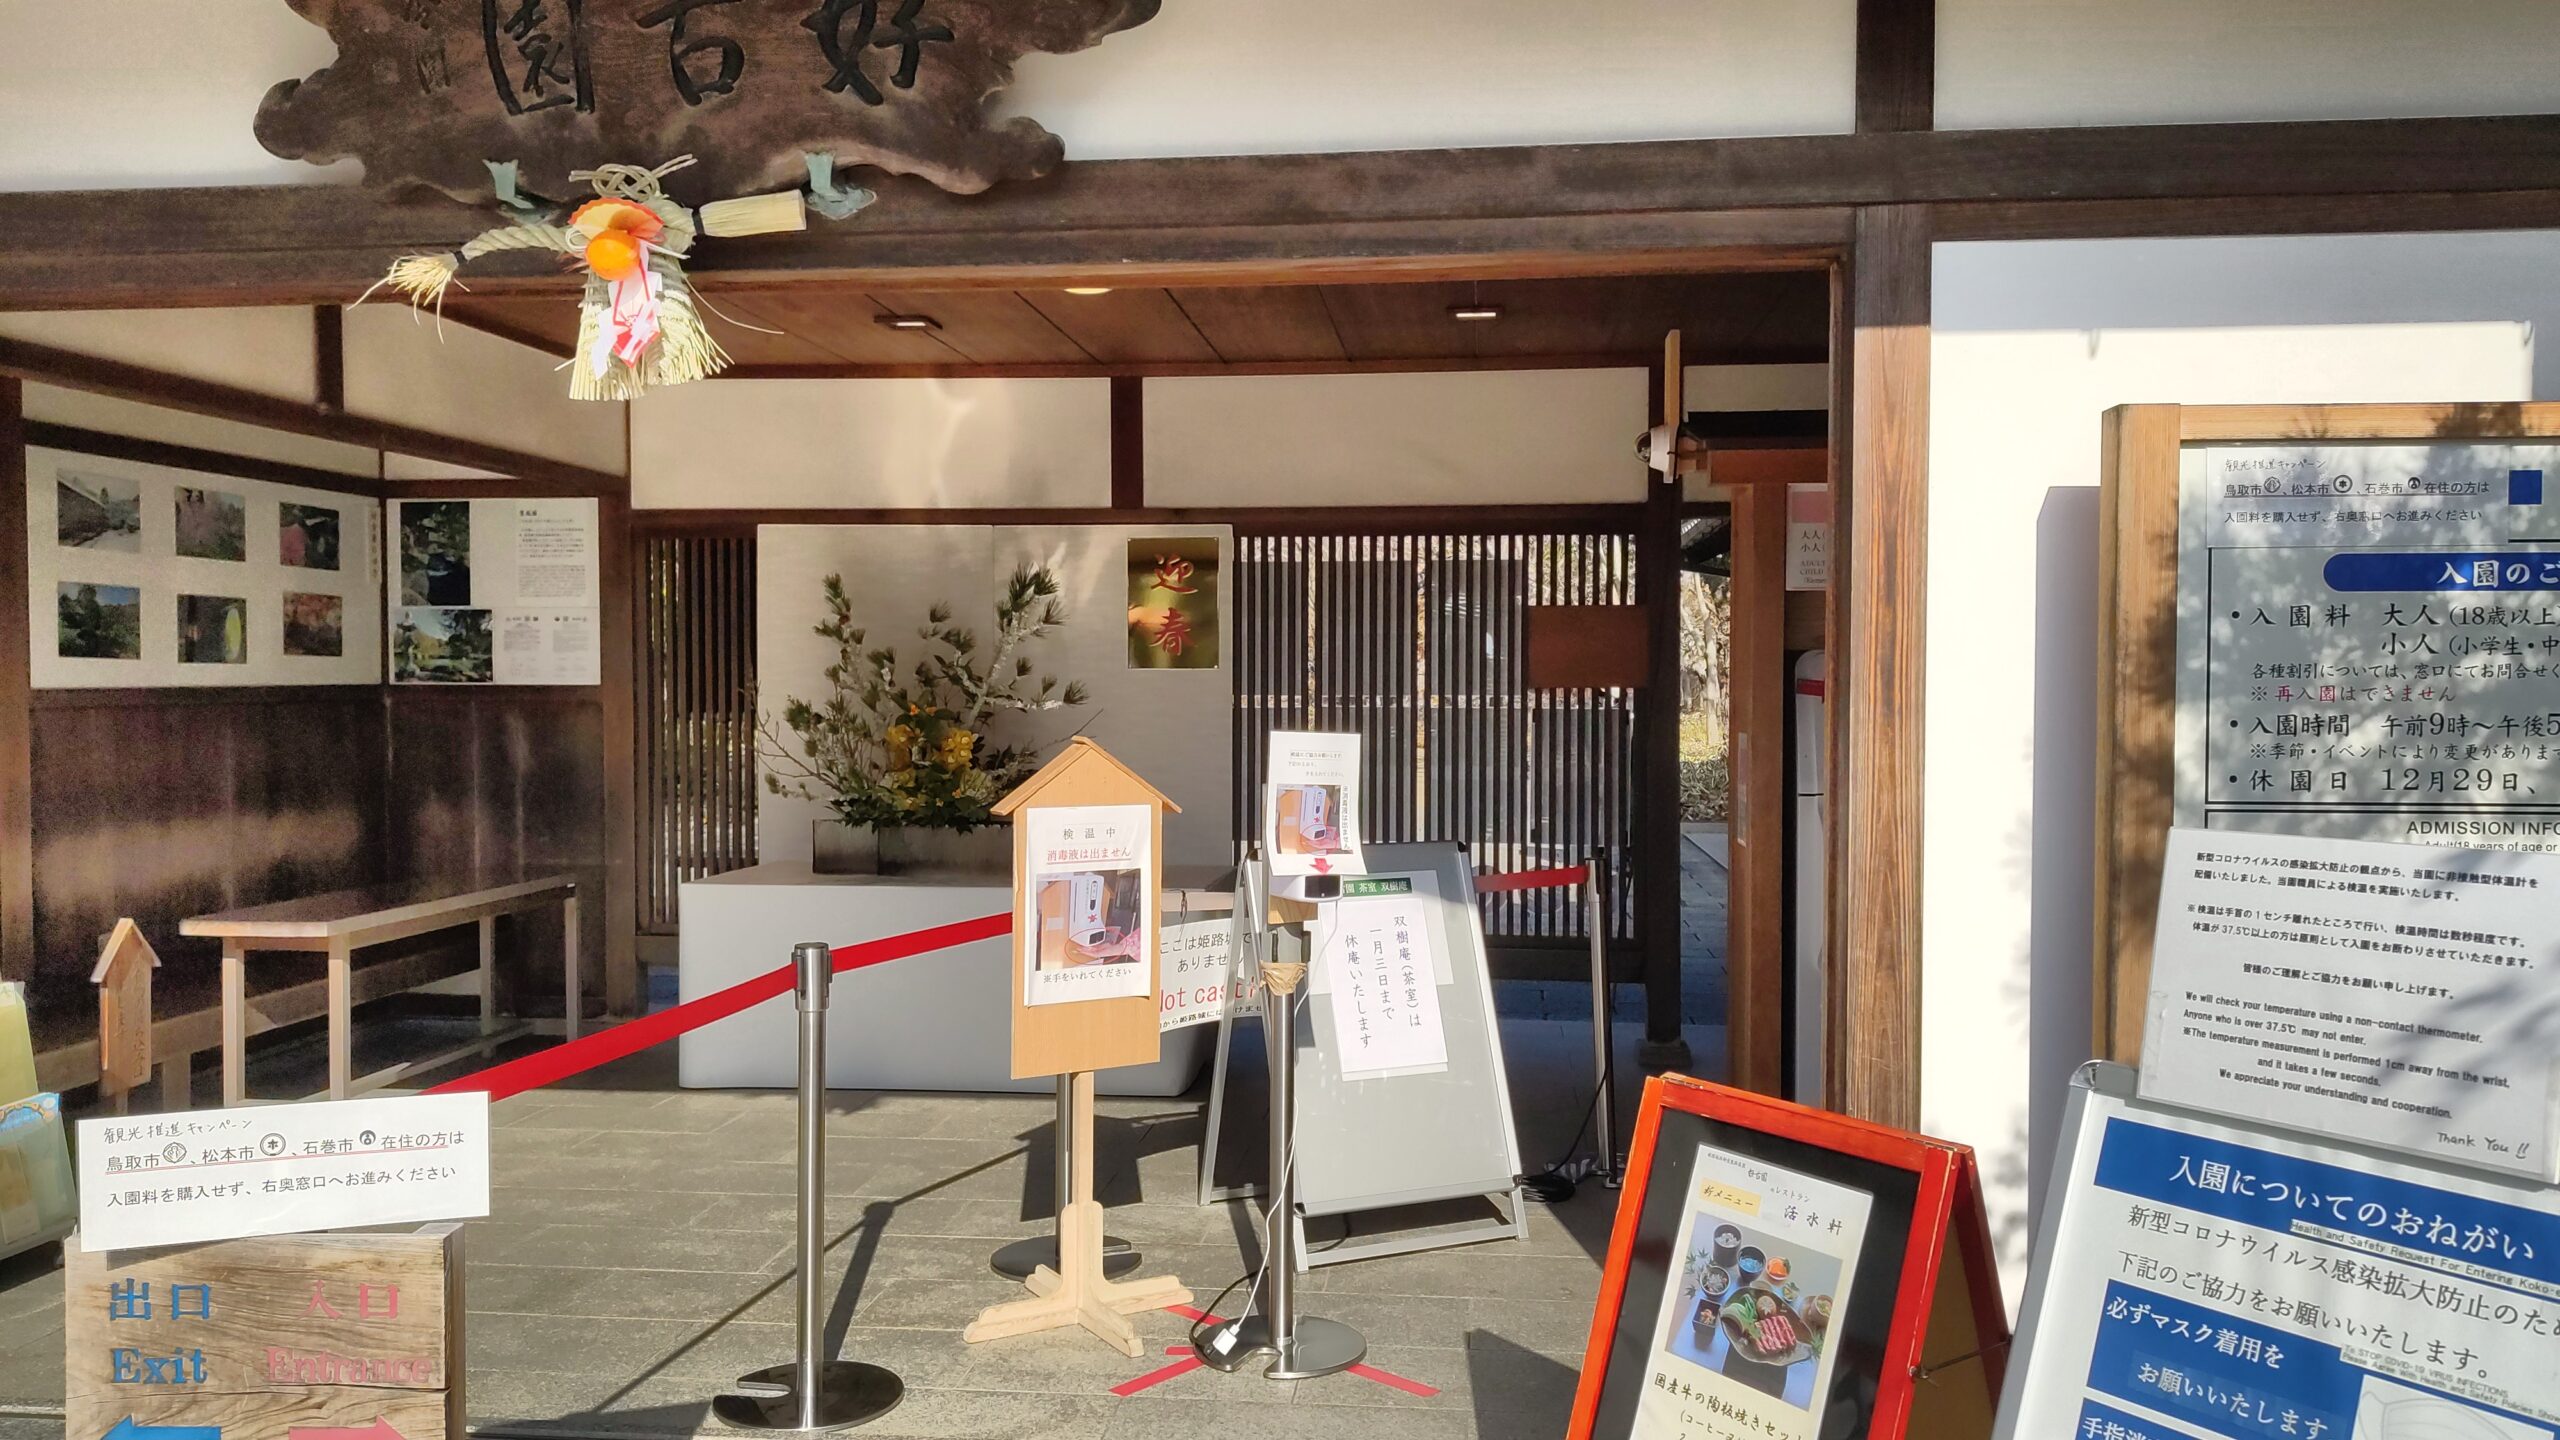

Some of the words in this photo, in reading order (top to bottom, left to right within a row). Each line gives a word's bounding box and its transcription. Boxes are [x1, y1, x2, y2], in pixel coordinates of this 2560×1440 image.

[2250, 603, 2350, 628] 入園料
[2249, 713, 2350, 737] 入園時間
[2249, 769, 2347, 793] 休園日
[1063, 826, 1116, 841] 検温中
[2406, 821, 2515, 836] ADMISSION
[1047, 847, 1131, 862] 消毒液は出ません
[1344, 934, 1372, 1049] 休庵いたします
[1370, 927, 1395, 1020] 一月三日まで
[2184, 1009, 2213, 1022] Anyone
[2215, 1014, 2231, 1024] who
[2234, 1016, 2242, 1026] is
[2244, 1019, 2262, 1029] over
[2301, 1027, 2319, 1038] may
[2322, 1030, 2336, 1041] not
[2340, 1032, 2367, 1046] enter.
[2185, 991, 2198, 1001] We
[2200, 994, 2213, 1003] will
[2215, 996, 2240, 1007] check
[2243, 1001, 2261, 1011] your
[2263, 1003, 2316, 1019] temperature
[2319, 1012, 2343, 1023] using
[2355, 1016, 2414, 1033] non-contact
[2417, 1025, 2483, 1043] thermometer.
[2209, 1031, 2260, 1047] temperature
[2261, 1040, 2320, 1056] measurement
[2322, 1049, 2330, 1059] is
[2333, 1051, 2381, 1067] performed
[2385, 1058, 2405, 1071] 1cm
[2408, 1064, 2433, 1076] away
[2436, 1067, 2459, 1080] from
[2462, 1071, 2479, 1083] the
[2482, 1075, 2510, 1088] wrist.
[2257, 1057, 2273, 1069] and
[2276, 1059, 2282, 1069] it
[2285, 1061, 2309, 1074] takes
[2312, 1067, 2318, 1075] a
[2321, 1067, 2337, 1079] few
[2340, 1072, 2381, 1087] seconds.
[2219, 1068, 2231, 1078] We
[2234, 1072, 2279, 1087] appreciate
[2282, 1082, 2301, 1092] your
[2304, 1084, 2368, 1104] understanding
[2371, 1096, 2389, 1107] and
[2392, 1100, 2453, 1119] cooperation.
[106, 1153, 161, 1172] 鳥取市
[380, 1130, 465, 1151] 在住の方は
[2437, 1132, 2476, 1147] Thank
[2484, 1136, 2509, 1153] You
[107, 1166, 456, 1208] 入園料を購入せず、右奥窓口へお進みください
[2168, 1155, 2534, 1260] 入園についてのおねがい
[1784, 1205, 1843, 1236] 活水軒
[2326, 1231, 2345, 1242] and
[2350, 1236, 2386, 1253] Safety
[2391, 1246, 2435, 1266] Request
[2441, 1258, 2460, 1271] For
[2465, 1264, 2513, 1285] Entering
[109, 1277, 212, 1321] 出口
[301, 1281, 399, 1320] 入口
[2118, 1249, 2488, 1379] 下記のご協力をお願いいたします。
[2106, 1296, 2284, 1369] 必ずマスク着用を
[112, 1347, 208, 1385] Exit
[264, 1346, 433, 1385] Entrance
